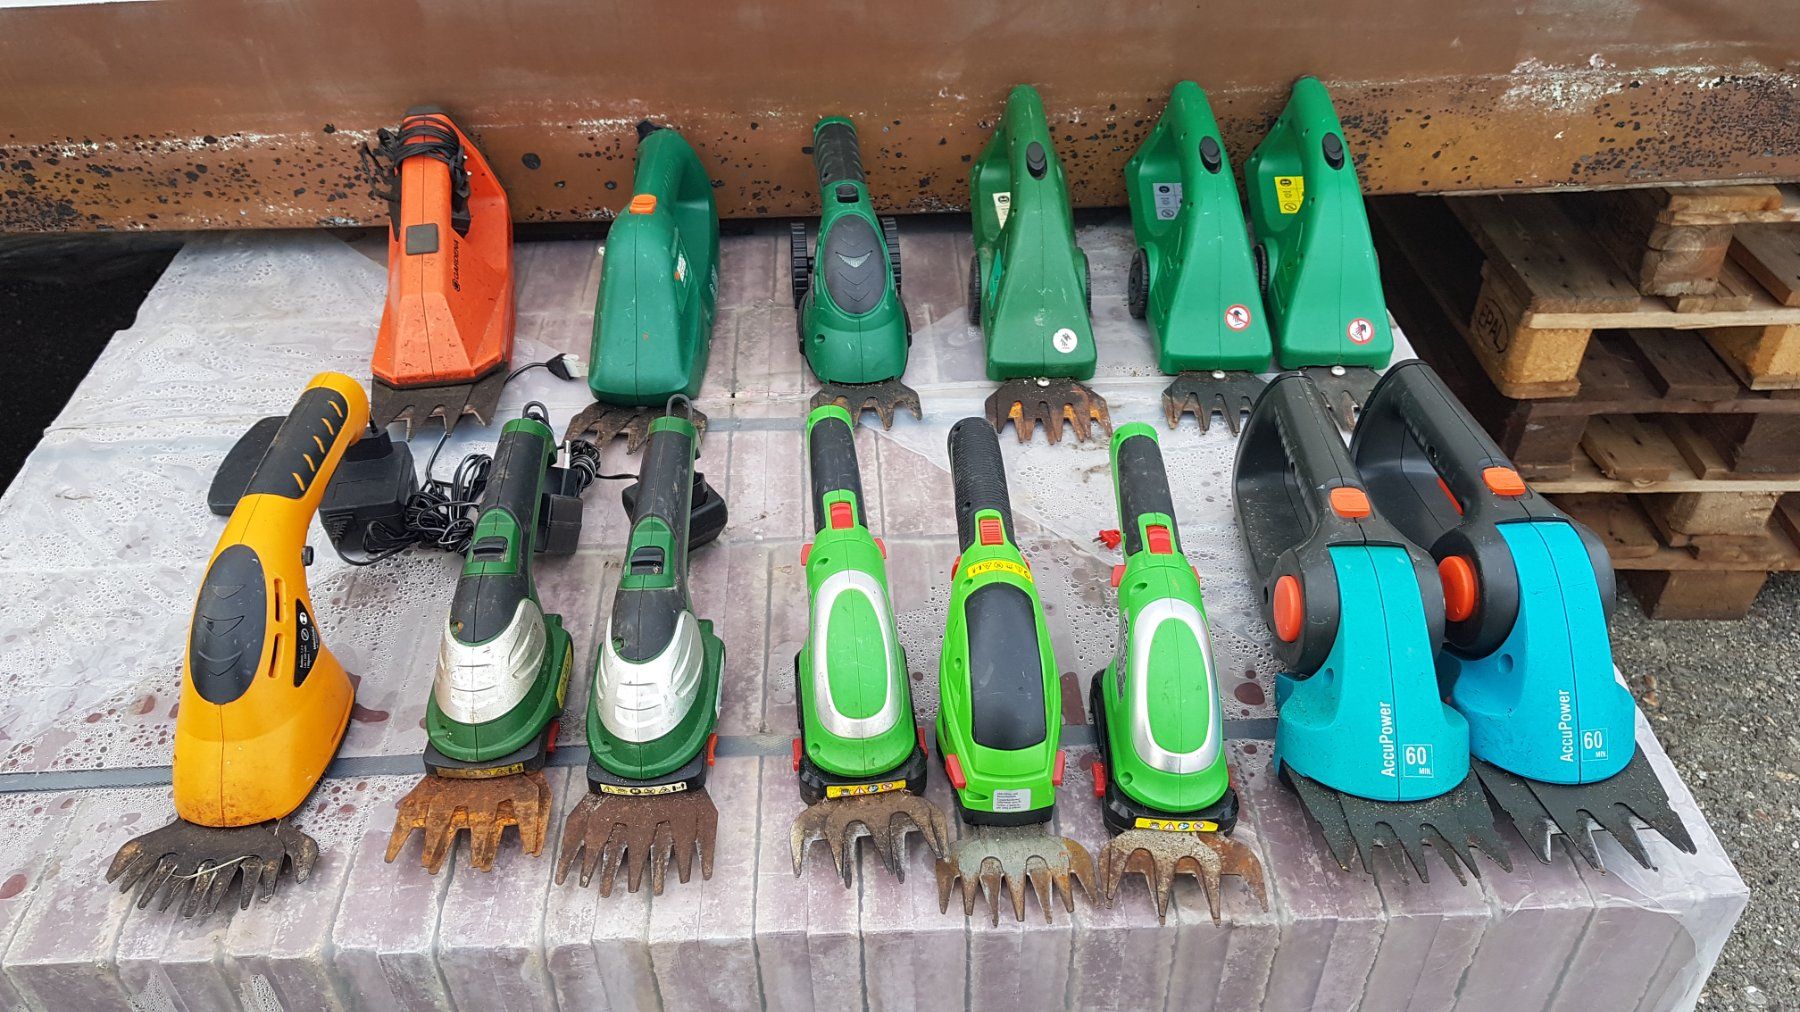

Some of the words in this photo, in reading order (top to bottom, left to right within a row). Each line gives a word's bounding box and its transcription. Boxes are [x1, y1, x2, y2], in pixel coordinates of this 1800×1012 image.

[1379, 701, 1396, 777] AccuPower
[1558, 689, 1574, 762] AccuPower
[1583, 731, 1603, 750] 60
[1405, 746, 1427, 765] 60
